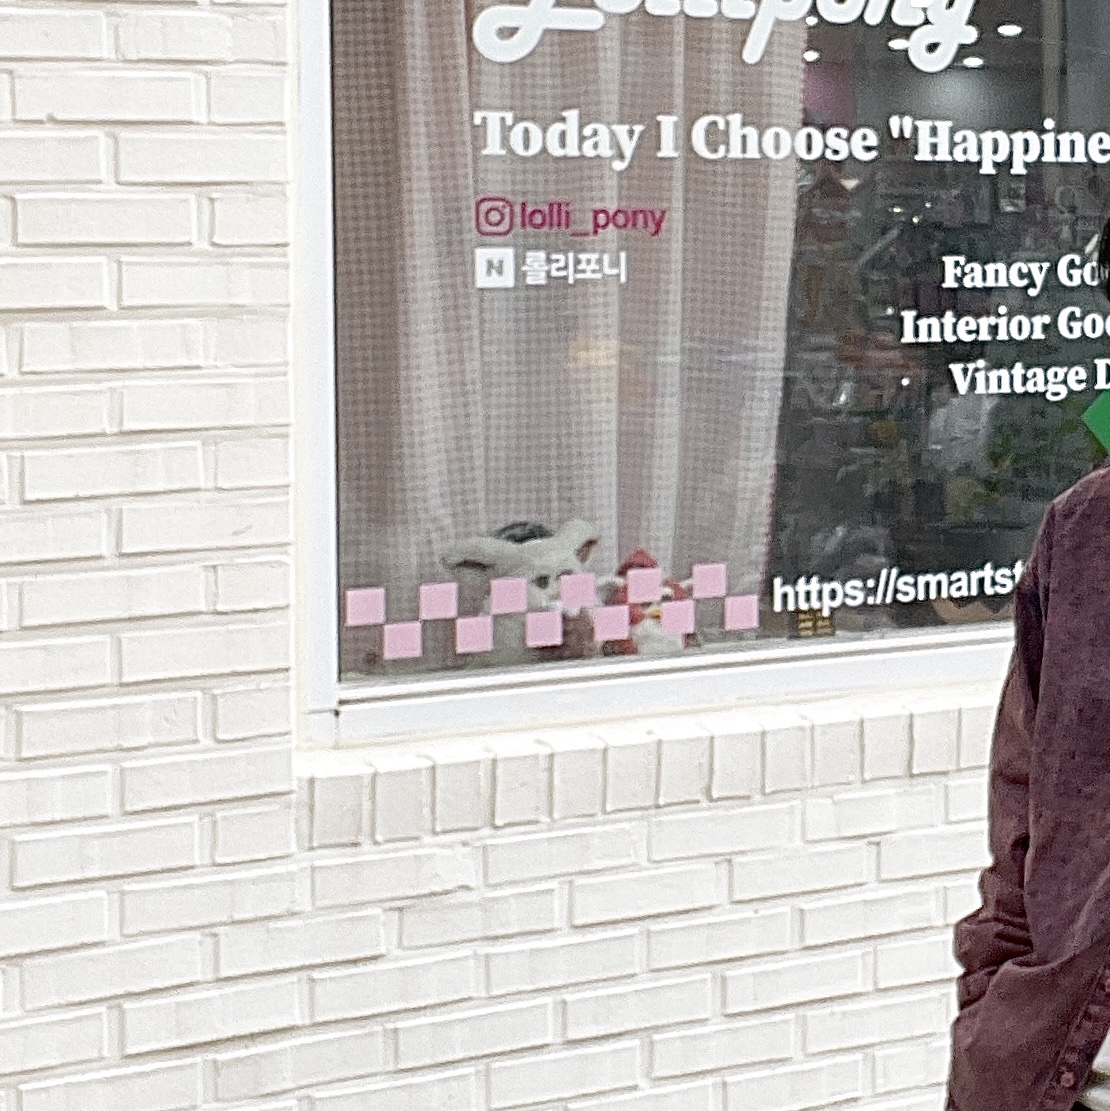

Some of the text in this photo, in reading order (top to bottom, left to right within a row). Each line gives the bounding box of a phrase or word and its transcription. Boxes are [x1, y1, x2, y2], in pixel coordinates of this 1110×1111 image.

[473, 109, 645, 171] Today
[656, 114, 680, 158] I
[691, 113, 879, 161] Choose
[520, 202, 667, 237] lolli_pony
[521, 249, 628, 286] 롤리포니
[941, 252, 1109, 297] Fancy Go
[900, 304, 1051, 344] Interior
[949, 358, 1088, 402] Vintage
[772, 559, 1023, 617] https://smartst
